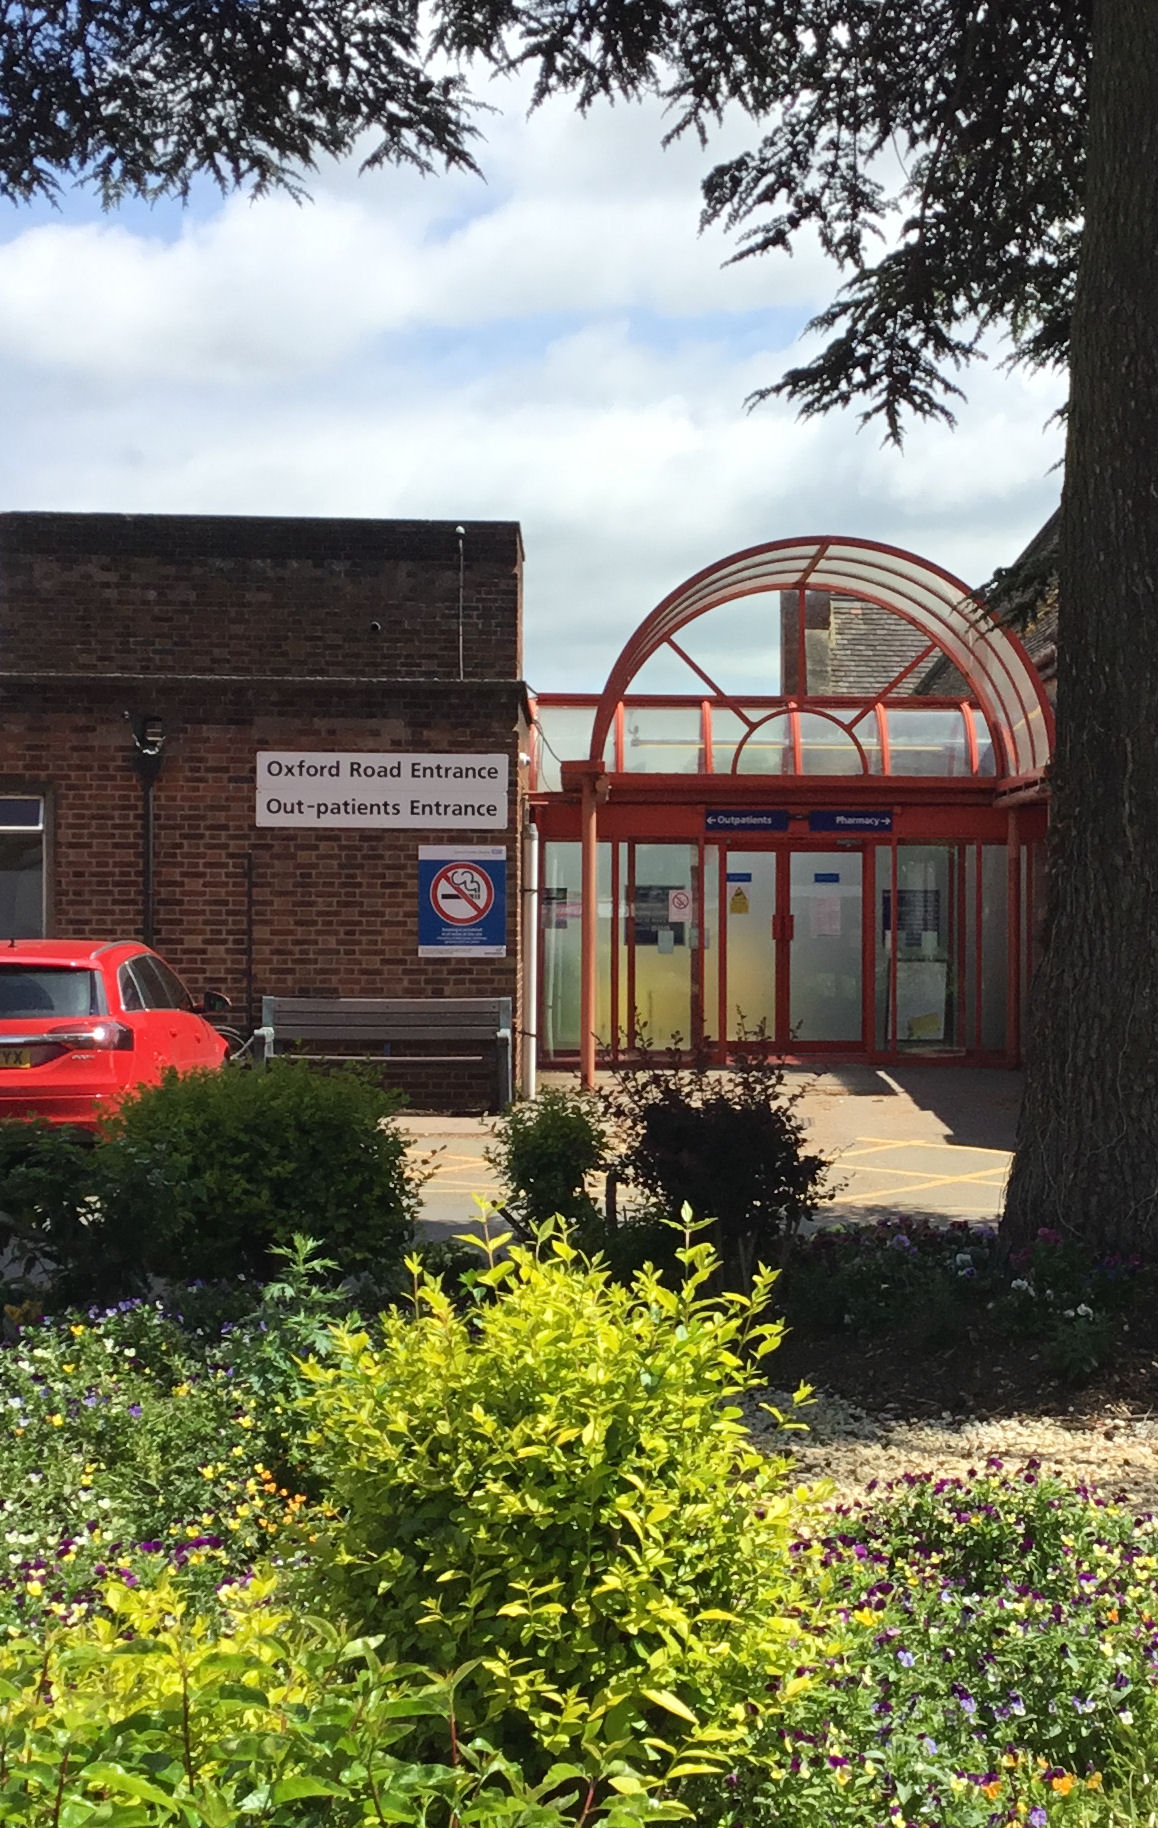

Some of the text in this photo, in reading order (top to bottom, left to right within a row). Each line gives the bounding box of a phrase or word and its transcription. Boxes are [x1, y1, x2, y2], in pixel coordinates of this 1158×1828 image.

[267, 760, 498, 779] Oxford Road Entrance
[266, 798, 498, 818] Out-patients Entrance
[717, 815, 880, 827] Outpatients Pharmacy
